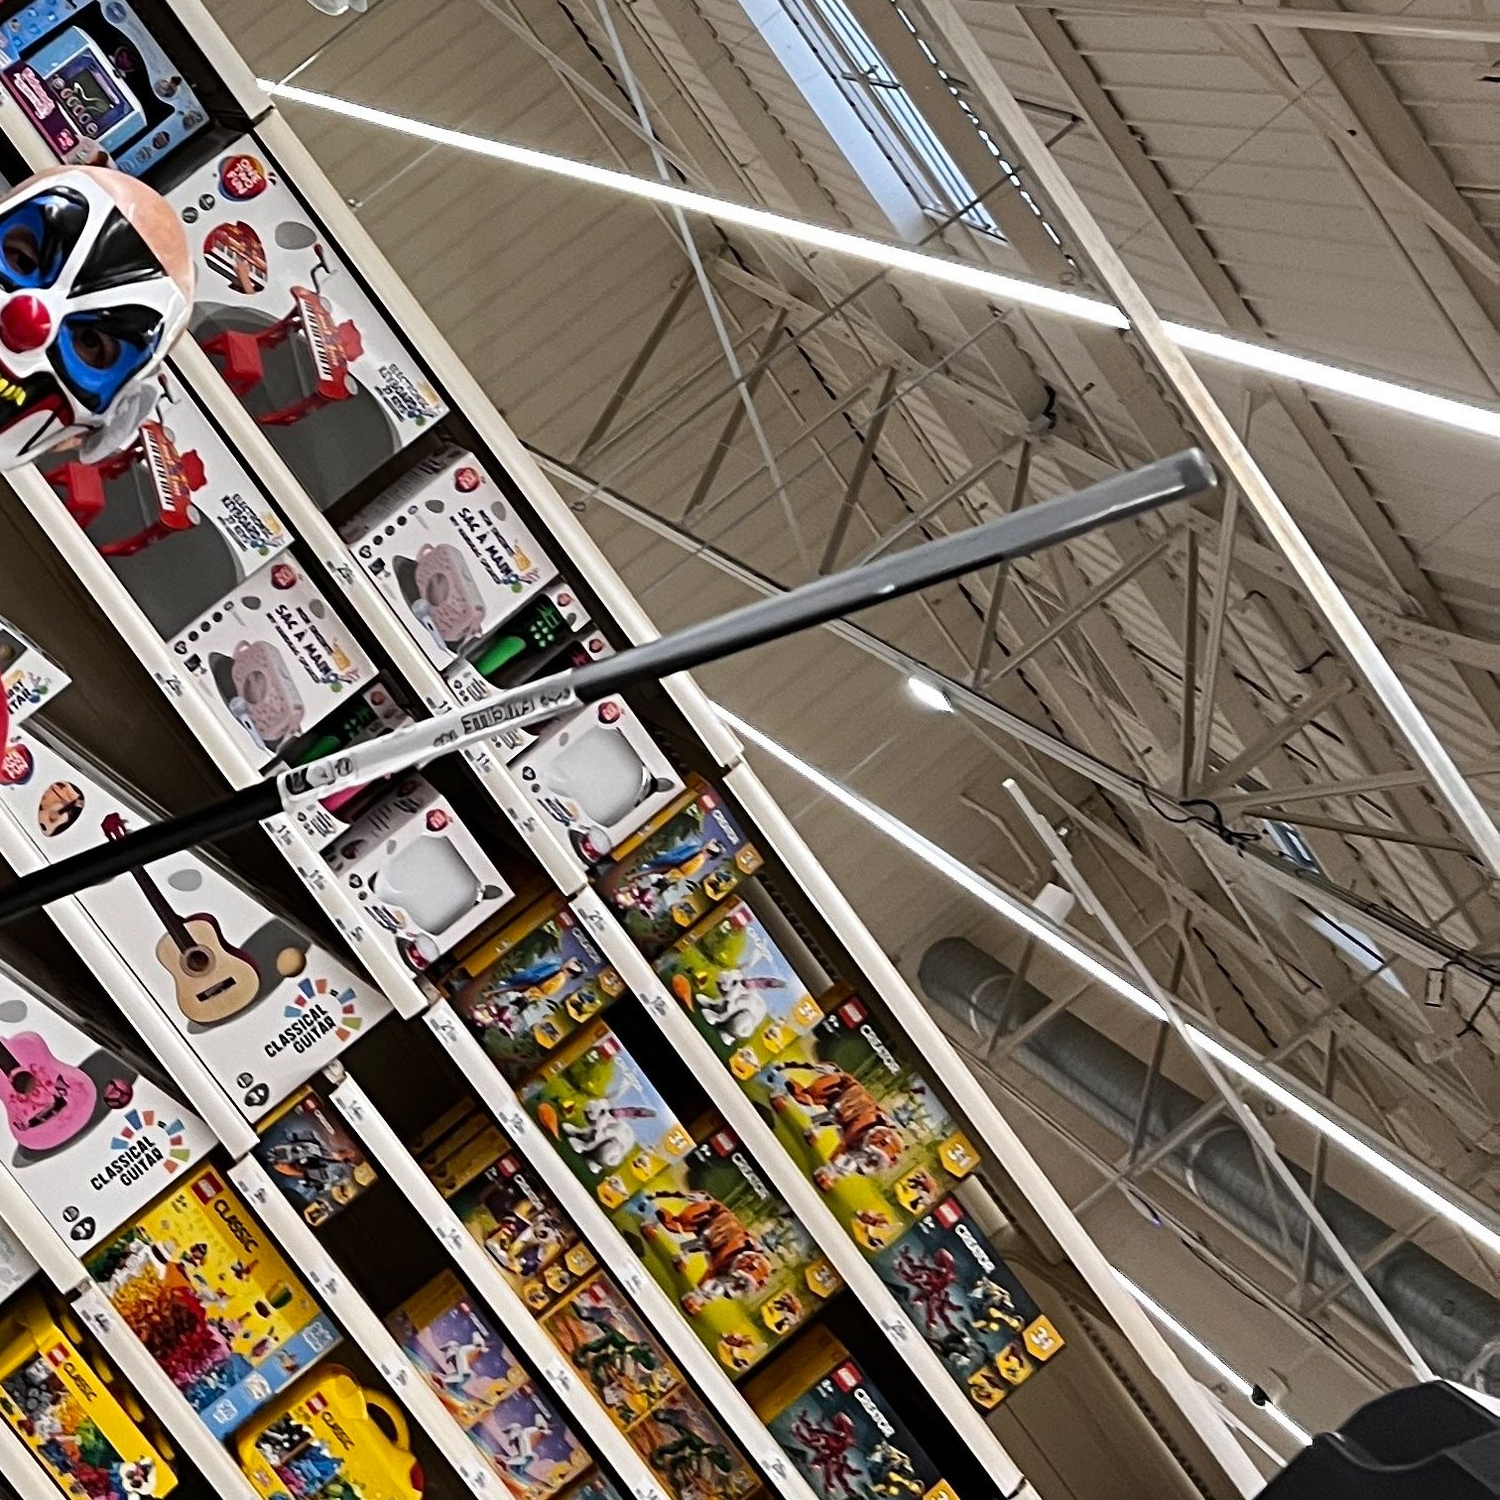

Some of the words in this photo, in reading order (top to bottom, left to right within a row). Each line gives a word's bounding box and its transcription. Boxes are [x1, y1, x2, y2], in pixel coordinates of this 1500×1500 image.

[377, 366, 418, 412] KEYBOARD
[389, 395, 408, 416] KEYS
[220, 495, 261, 541] KEYBOARD
[232, 525, 251, 545] KEYS
[456, 506, 482, 533] SAC
[484, 543, 516, 578] MAIN
[273, 603, 299, 630] SAC
[301, 641, 334, 678] MAIN
[263, 1001, 328, 1059] CLASSICAL
[292, 1017, 336, 1056] GUITAR
[857, 1022, 901, 1075] CREATOR
[88, 1134, 156, 1192] CLASSICAL
[117, 1147, 164, 1188] GUITAR
[729, 1151, 771, 1200] CREATOR
[210, 1196, 260, 1254] CLASSIC
[952, 1221, 996, 1274] CREATOR
[60, 1360, 99, 1403] CLASSIC
[318, 1409, 356, 1451] CLASSIC
[851, 1386, 896, 1438] CREATOR
